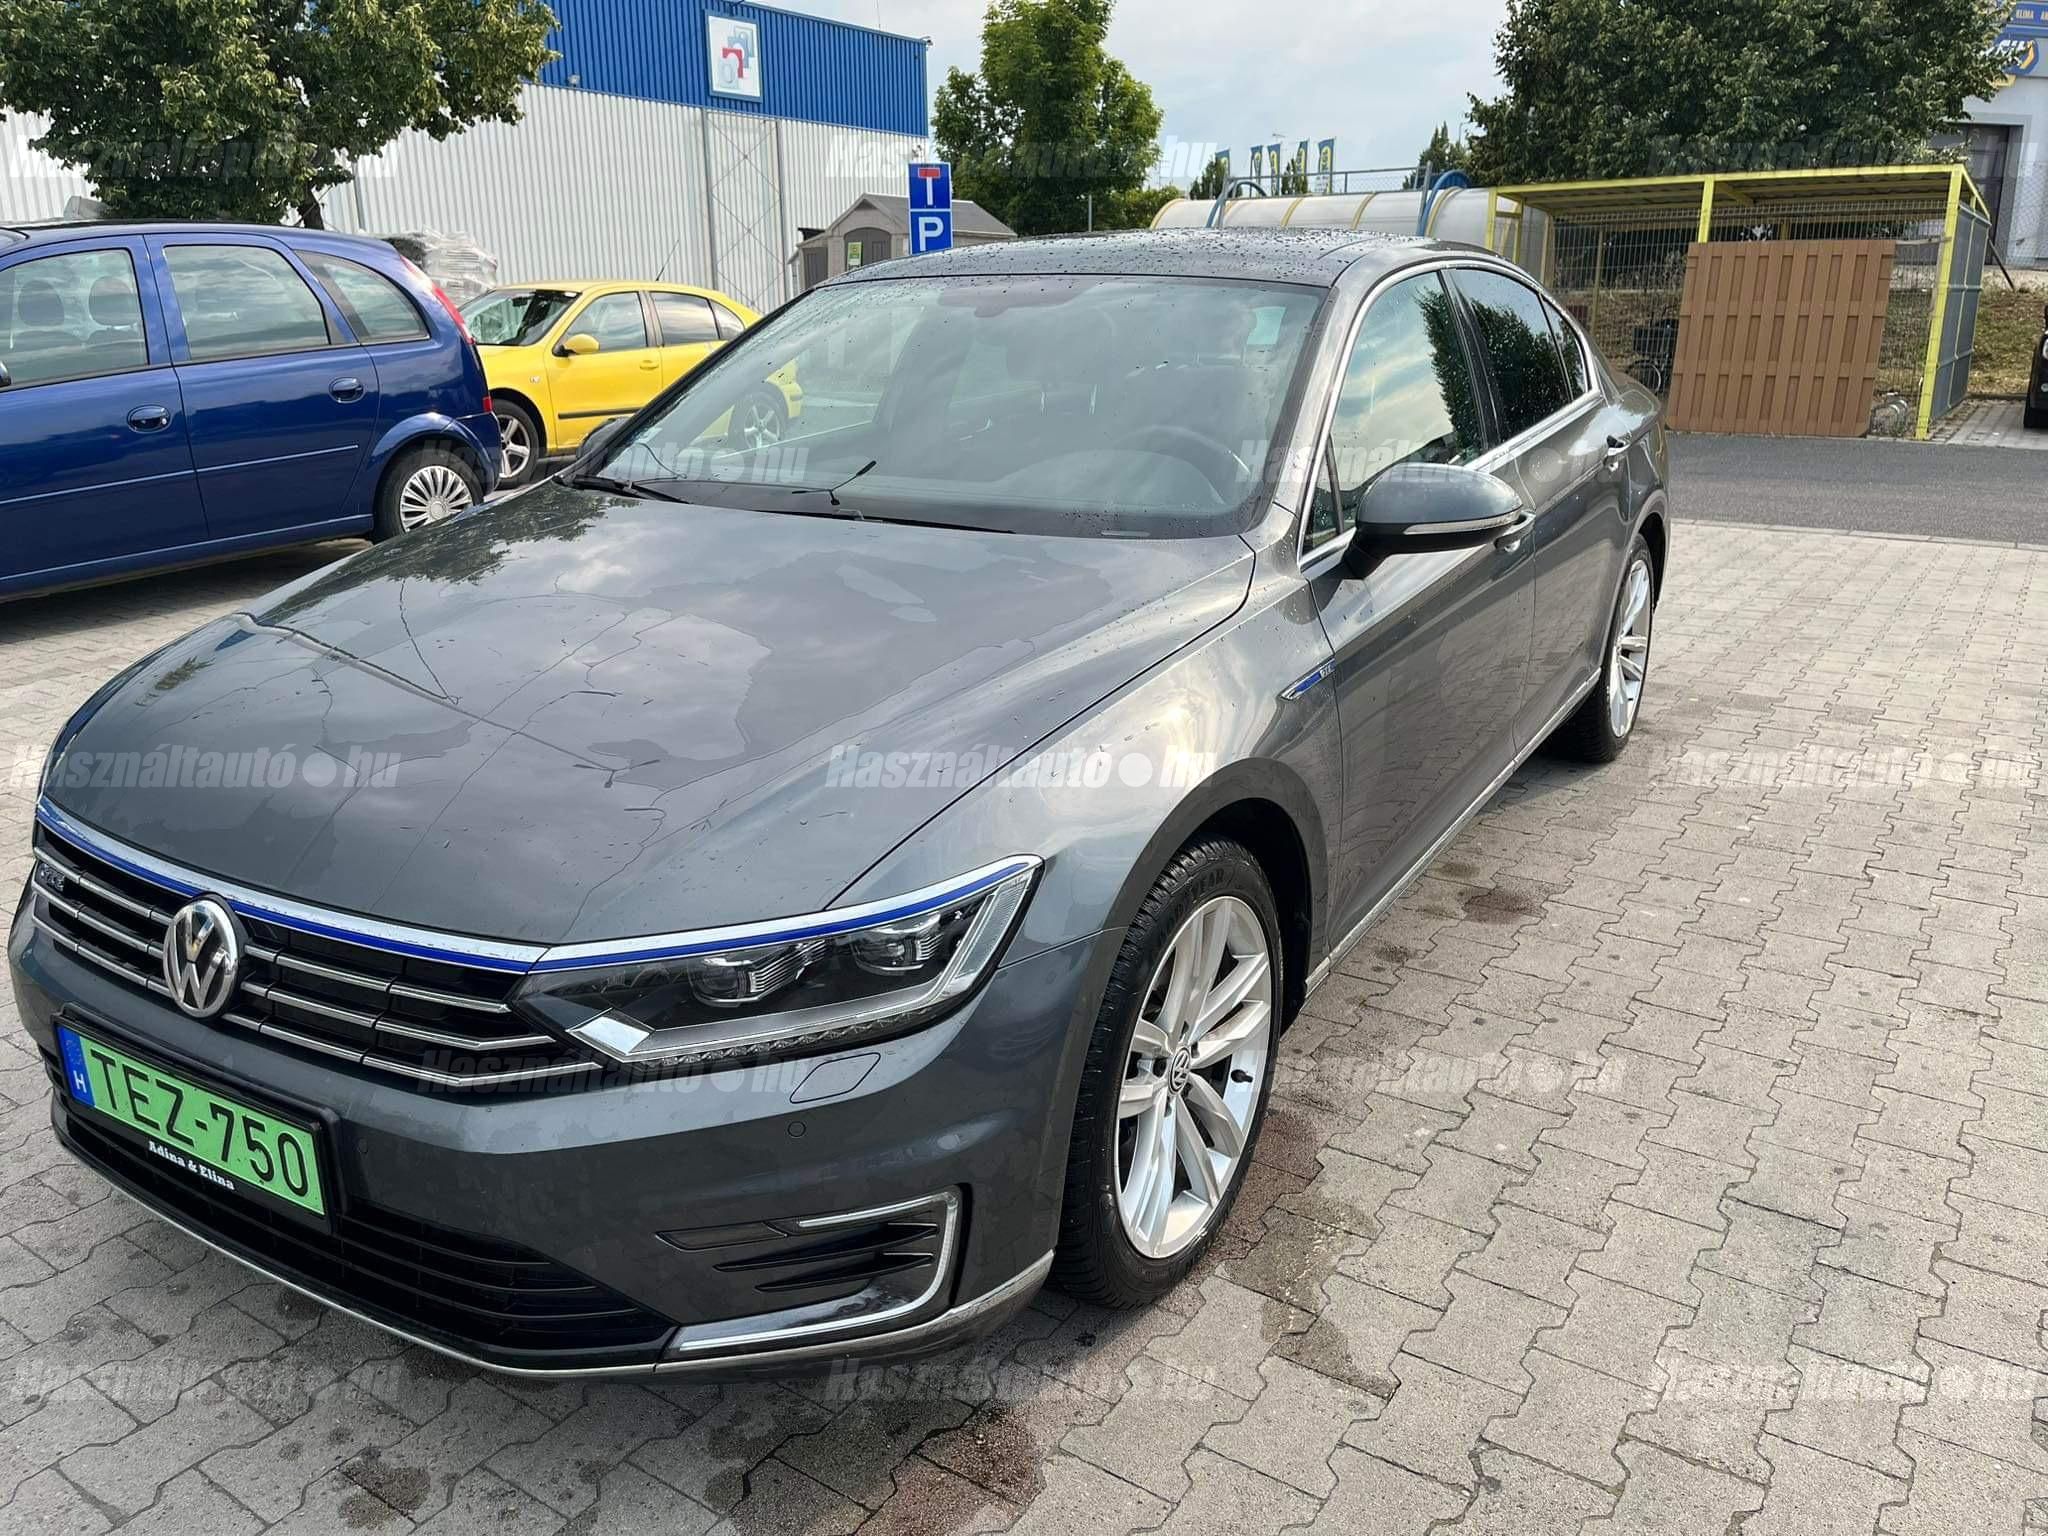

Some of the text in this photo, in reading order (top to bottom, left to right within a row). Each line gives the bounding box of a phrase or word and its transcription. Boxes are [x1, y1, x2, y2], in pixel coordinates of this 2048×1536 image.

[919, 216, 944, 252] P
[73, 1069, 88, 1094] H
[90, 1048, 309, 1198] TEZ-750
[148, 1140, 235, 1190] Adina & Elina
